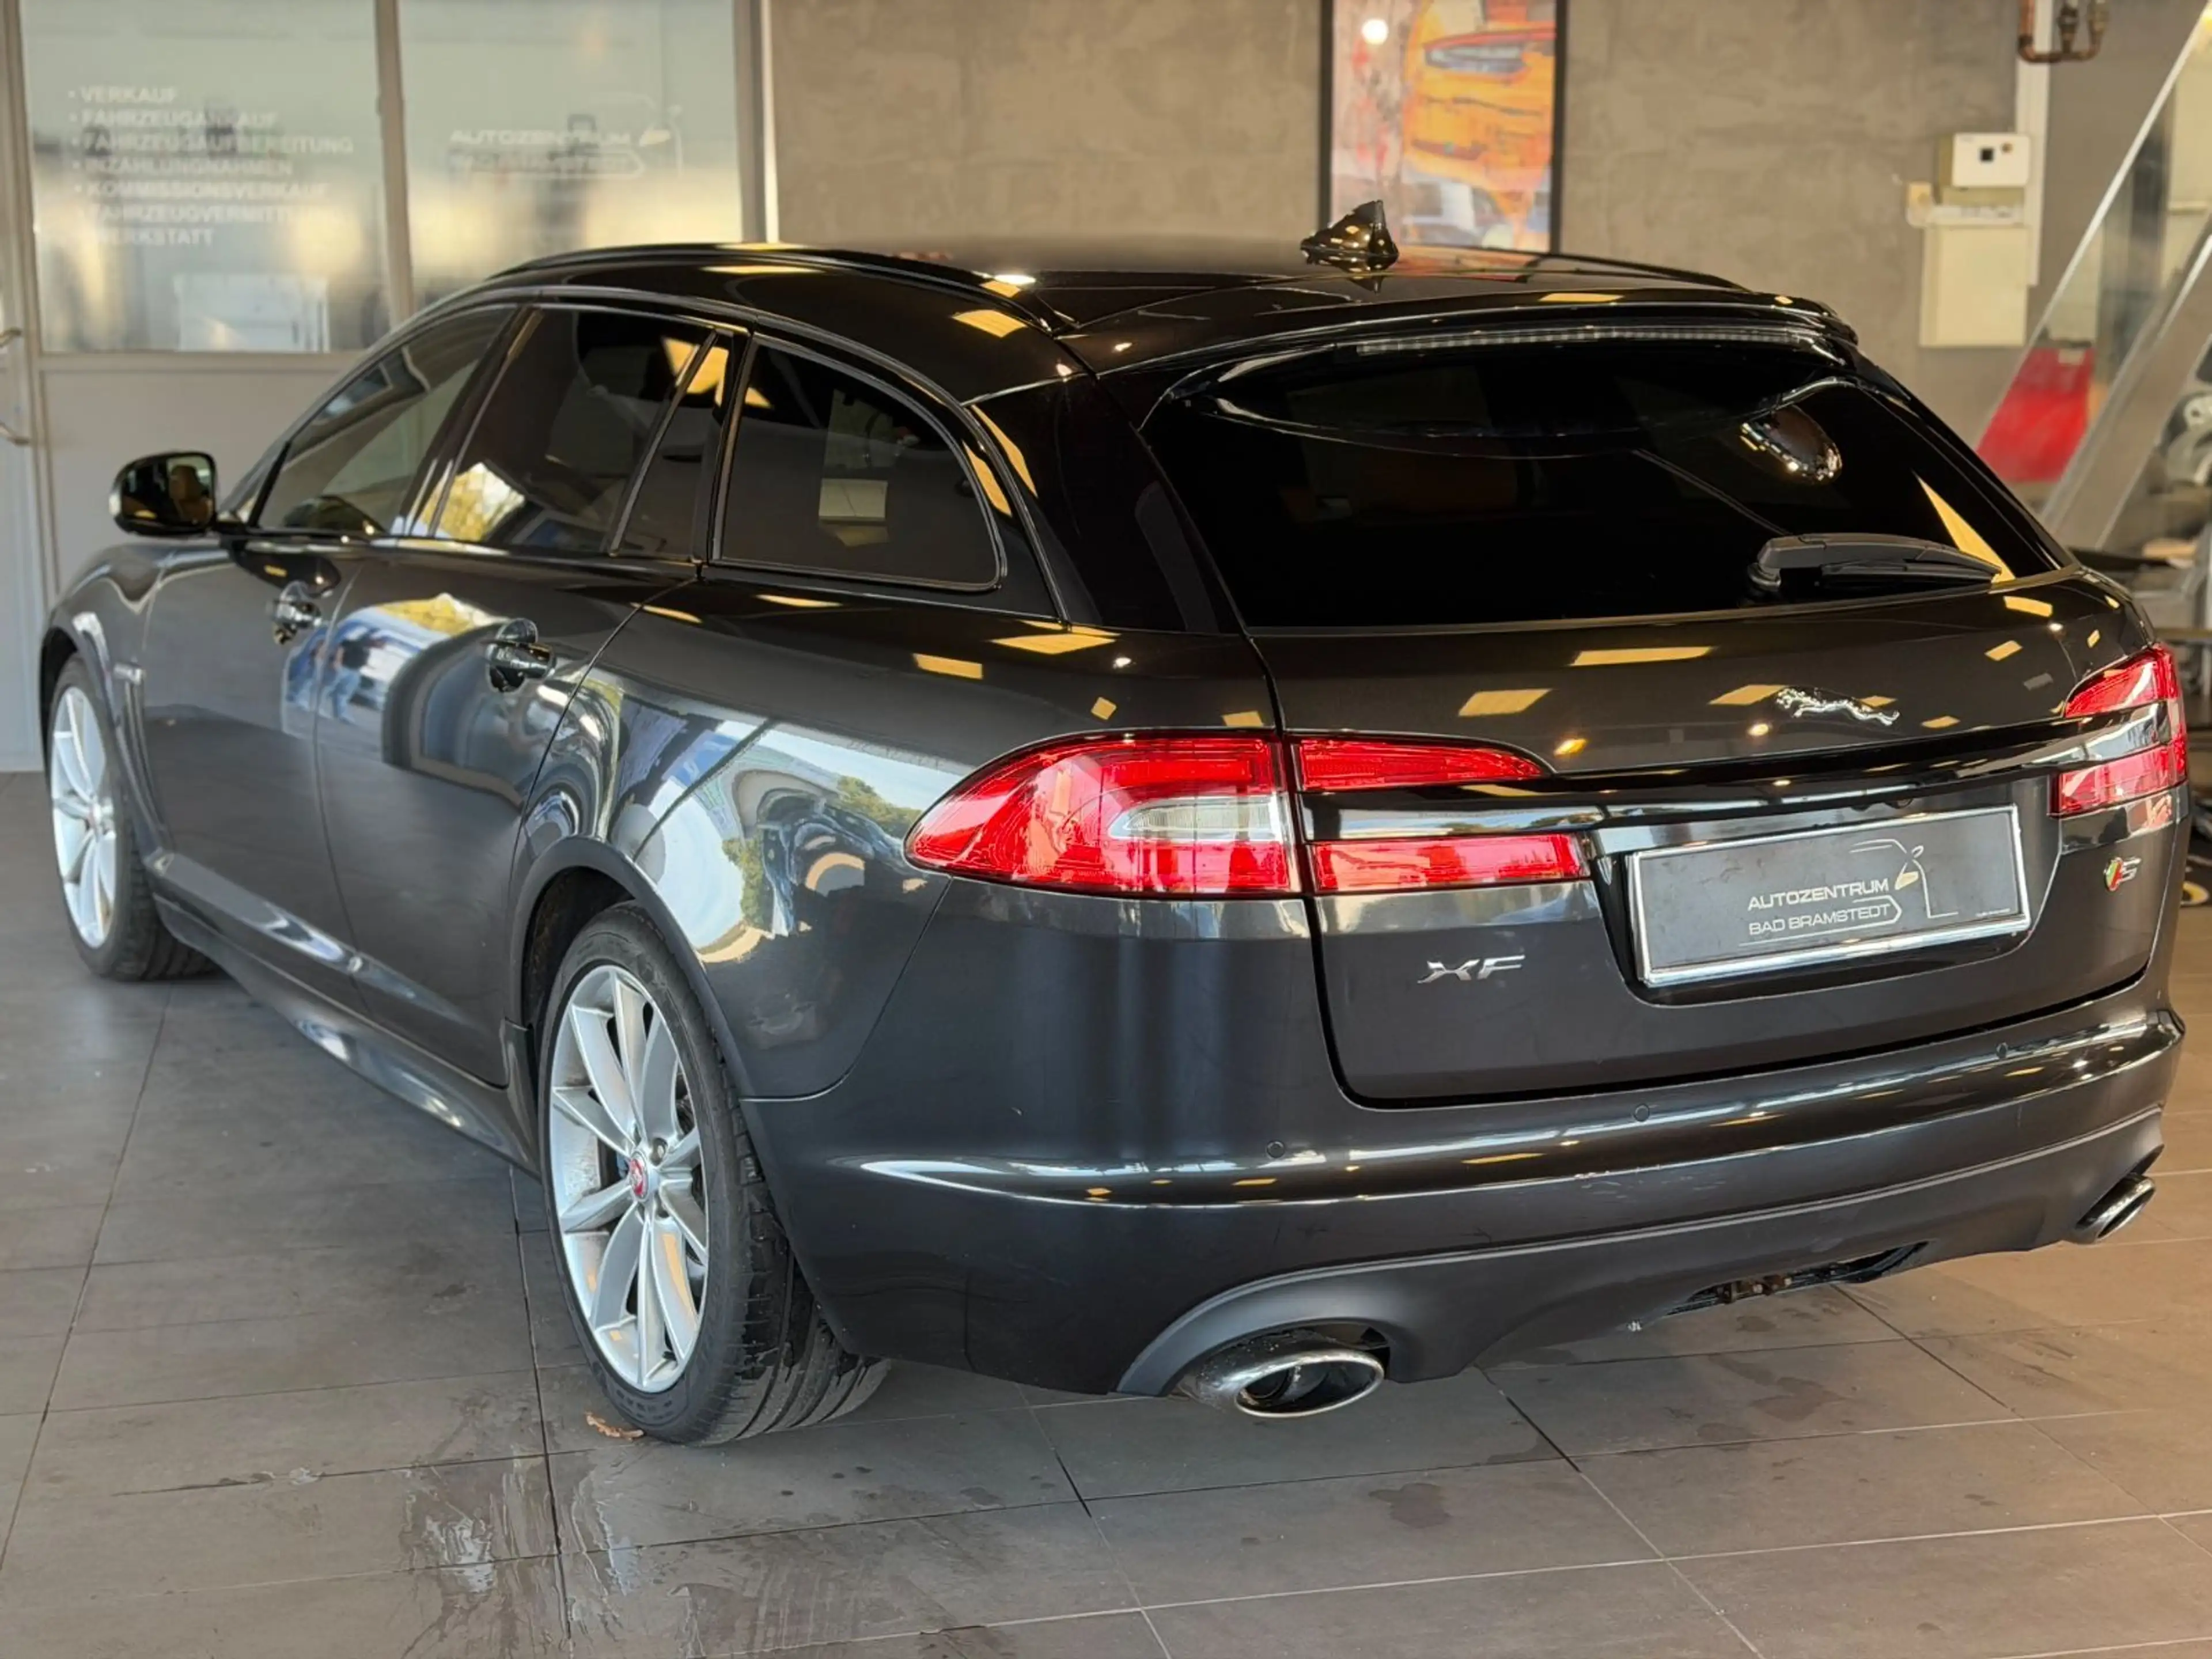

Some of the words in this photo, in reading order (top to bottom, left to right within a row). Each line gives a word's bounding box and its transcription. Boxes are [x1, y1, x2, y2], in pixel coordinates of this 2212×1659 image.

[80, 86, 177, 103] VERKAUF
[1748, 878, 1889, 911] AUTOZENTRUM
[1749, 919, 1786, 935] BAD
[1789, 903, 1891, 930] BRAMSTEDT
[1417, 955, 1525, 984] XF
